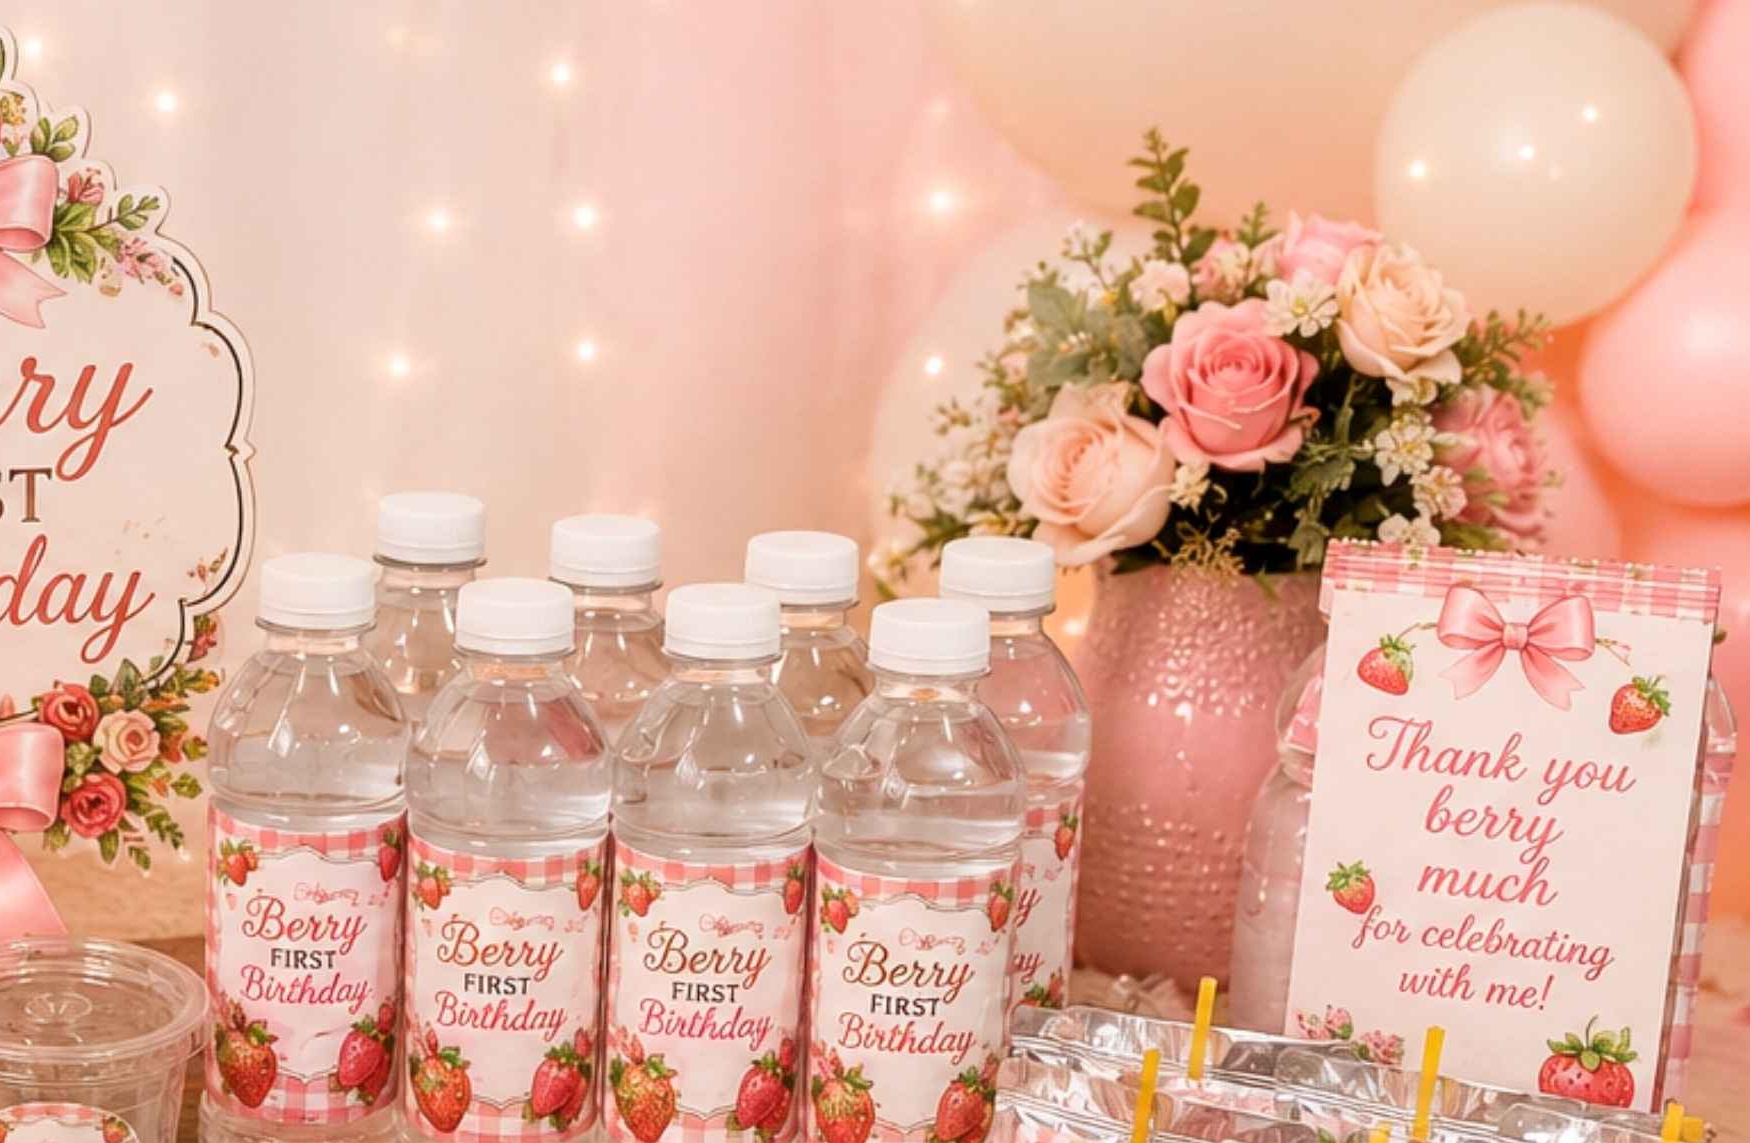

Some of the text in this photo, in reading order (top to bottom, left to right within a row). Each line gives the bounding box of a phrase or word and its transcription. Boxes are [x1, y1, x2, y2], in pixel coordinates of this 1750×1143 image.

[1366, 716, 1636, 805] Thank you
[1425, 785, 1565, 865] berry
[1417, 856, 1558, 906] much
[242, 890, 367, 955] Berry
[437, 915, 563, 982] Berry
[1351, 905, 1615, 980] for celebrating
[270, 947, 336, 969] FIRST
[644, 921, 771, 989] Berry
[842, 934, 975, 1003] Berry
[240, 964, 371, 1014] Birthday
[463, 973, 531, 995] FIRST
[672, 982, 739, 1003] FIRST
[870, 994, 940, 1017] FIRST
[1399, 965, 1554, 1010] with me!
[435, 991, 567, 1042] Birthday
[639, 998, 773, 1051] Birthday
[838, 1011, 976, 1064] Birthday
